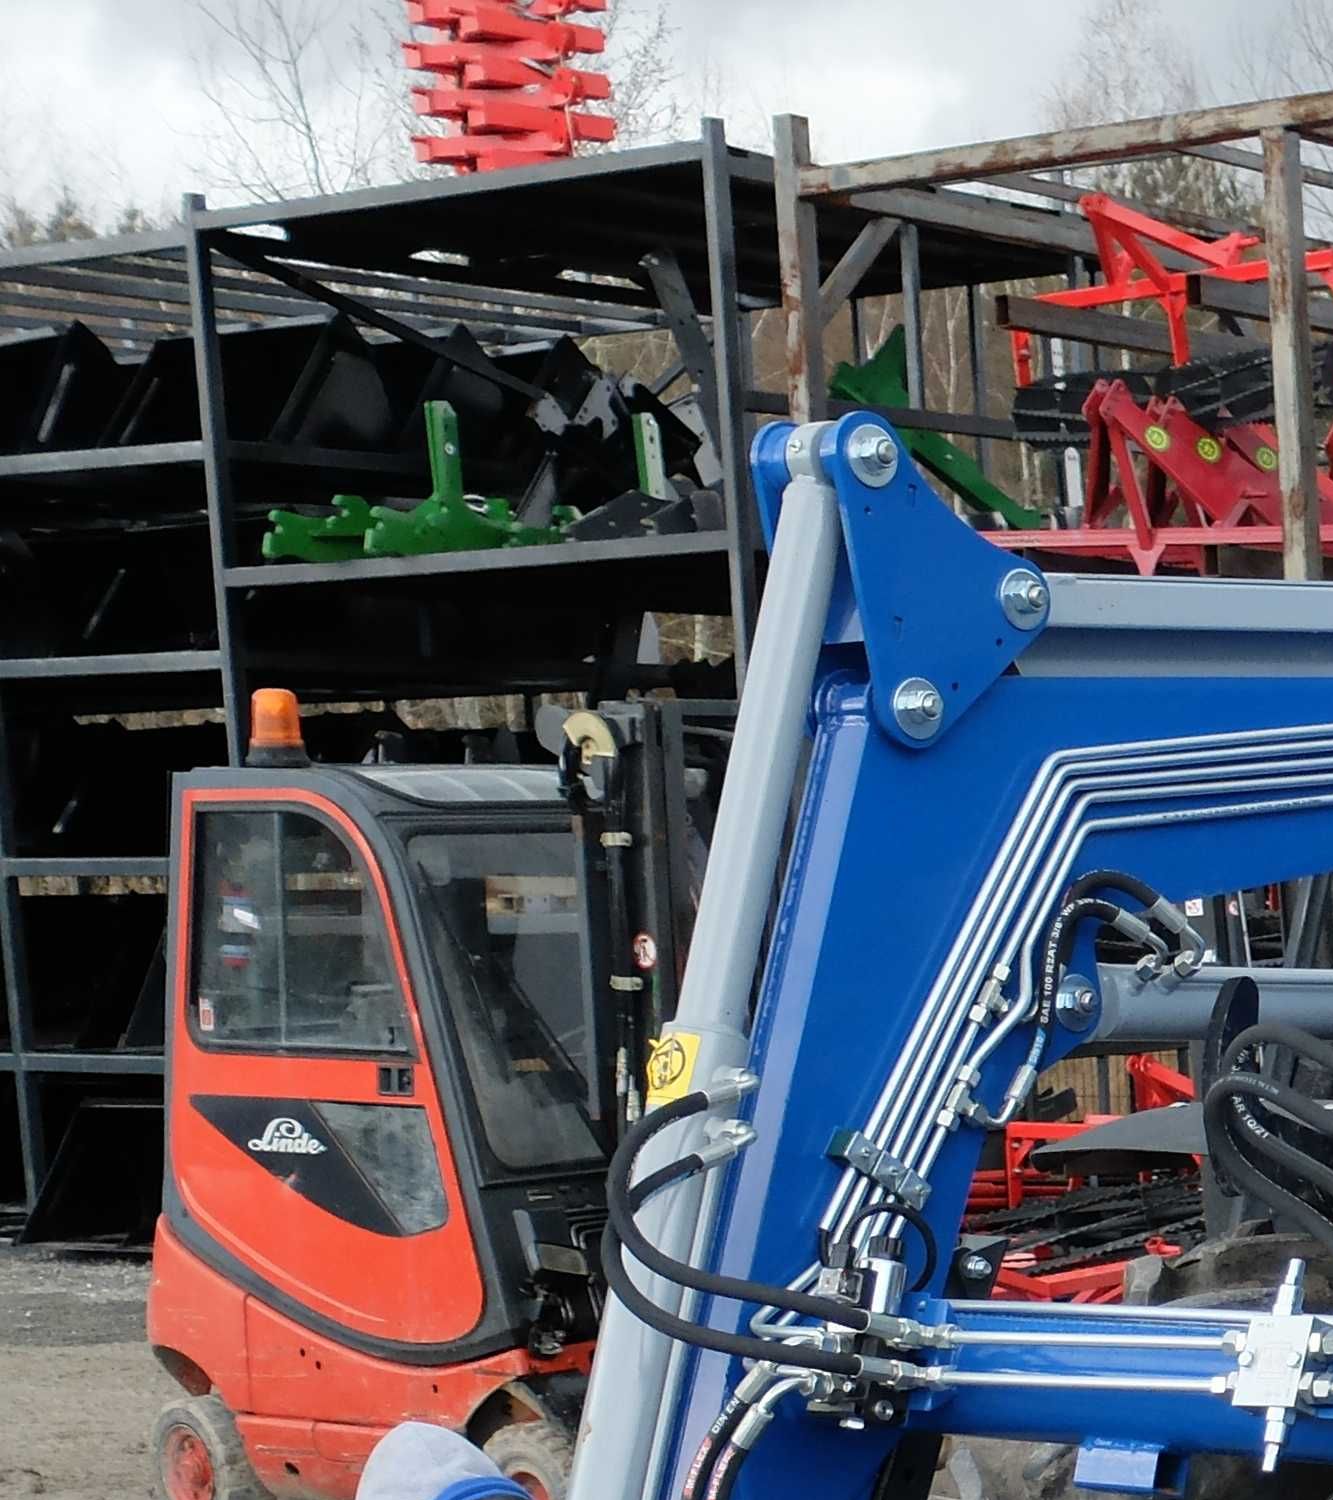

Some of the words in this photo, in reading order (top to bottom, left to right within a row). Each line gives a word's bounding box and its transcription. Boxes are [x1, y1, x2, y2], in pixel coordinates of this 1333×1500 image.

[1043, 966, 1055, 999] 100
[247, 1117, 328, 1155] Linde
[711, 1415, 729, 1434] DIN
